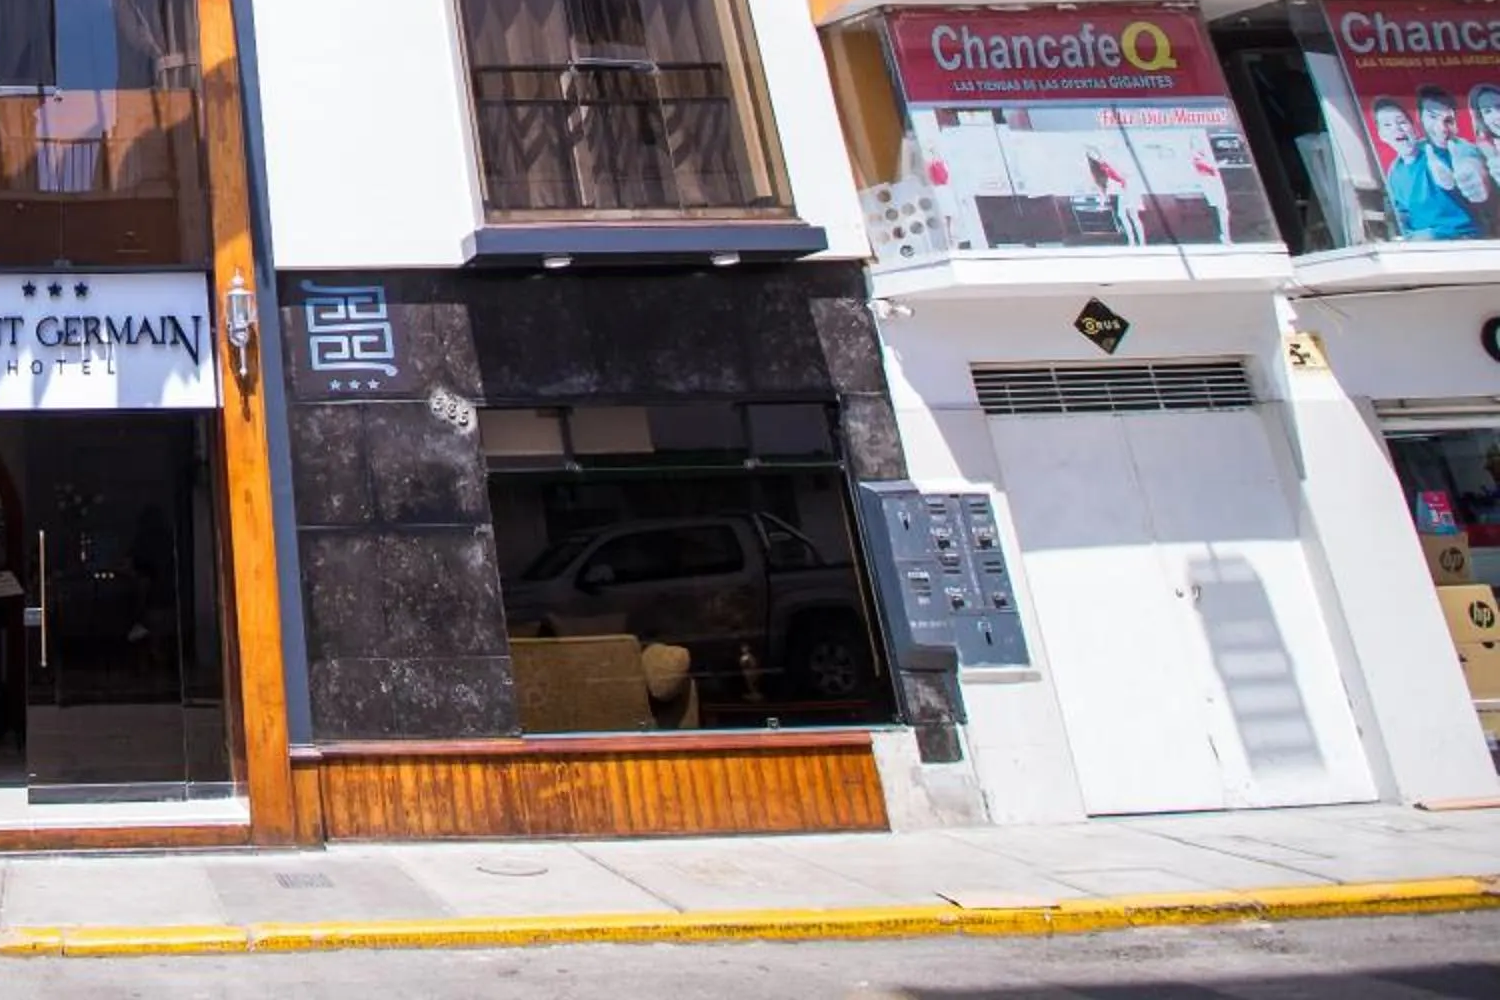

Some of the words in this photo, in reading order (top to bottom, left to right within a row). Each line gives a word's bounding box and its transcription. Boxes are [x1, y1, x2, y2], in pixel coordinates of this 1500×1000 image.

[931, 21, 1177, 71] ChancafeQ
[953, 80, 975, 92] LAS
[977, 79, 1020, 92] TIENDAS
[1039, 78, 1059, 91] LAS
[1061, 77, 1107, 90] OFERTAS
[1109, 75, 1173, 90] GIGANTES
[35, 315, 202, 367] GERMAIN
[6, 358, 116, 376] HOTEL
[1471, 600, 1493, 628] hp
